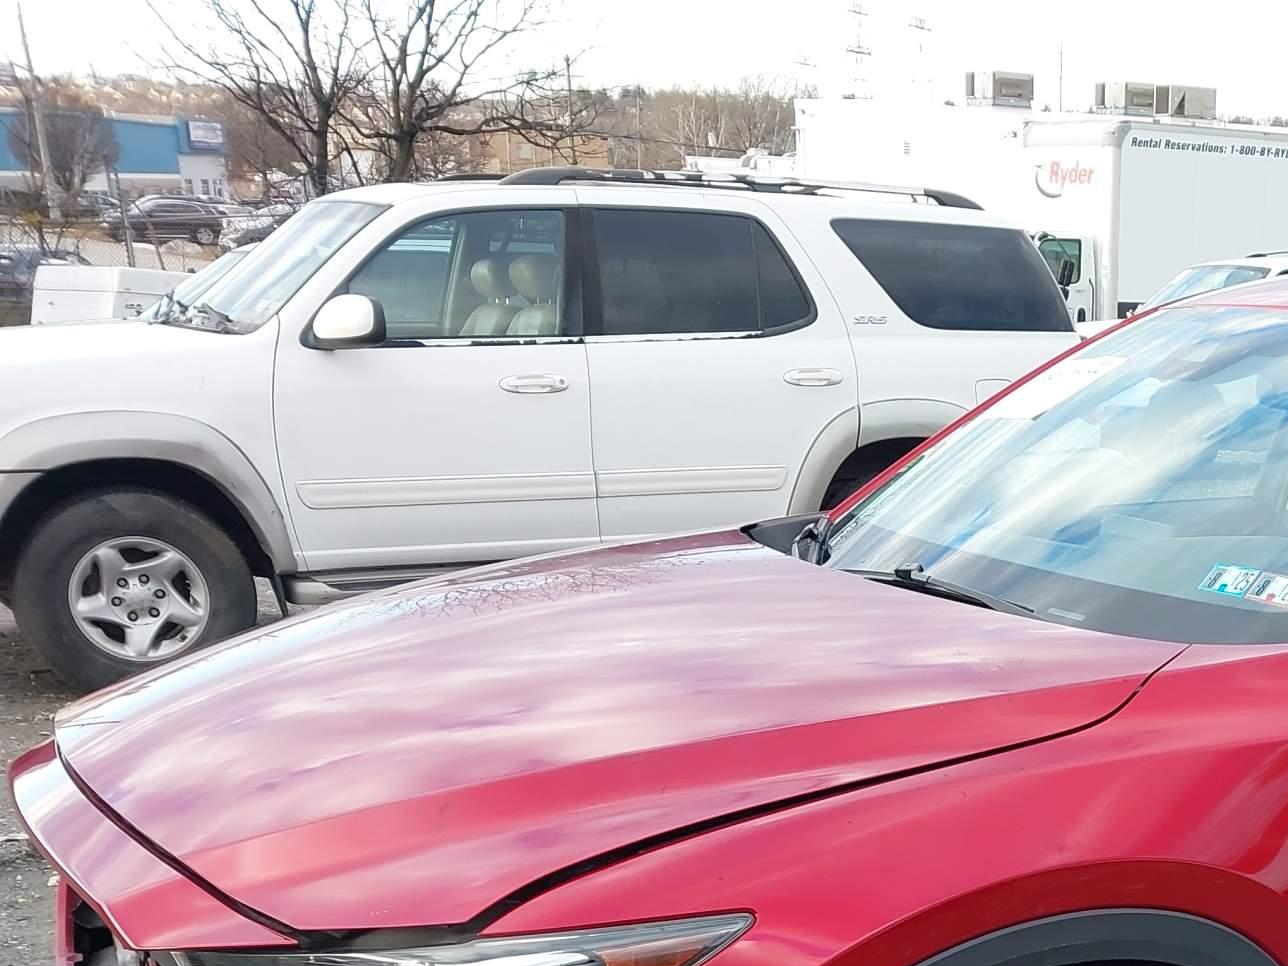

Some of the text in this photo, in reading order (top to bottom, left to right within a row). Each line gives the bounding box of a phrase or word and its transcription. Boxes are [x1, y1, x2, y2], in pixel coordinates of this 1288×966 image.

[1131, 136, 1161, 149] Rental
[1164, 139, 1228, 154] Reservations:
[1048, 159, 1096, 190] Ryder
